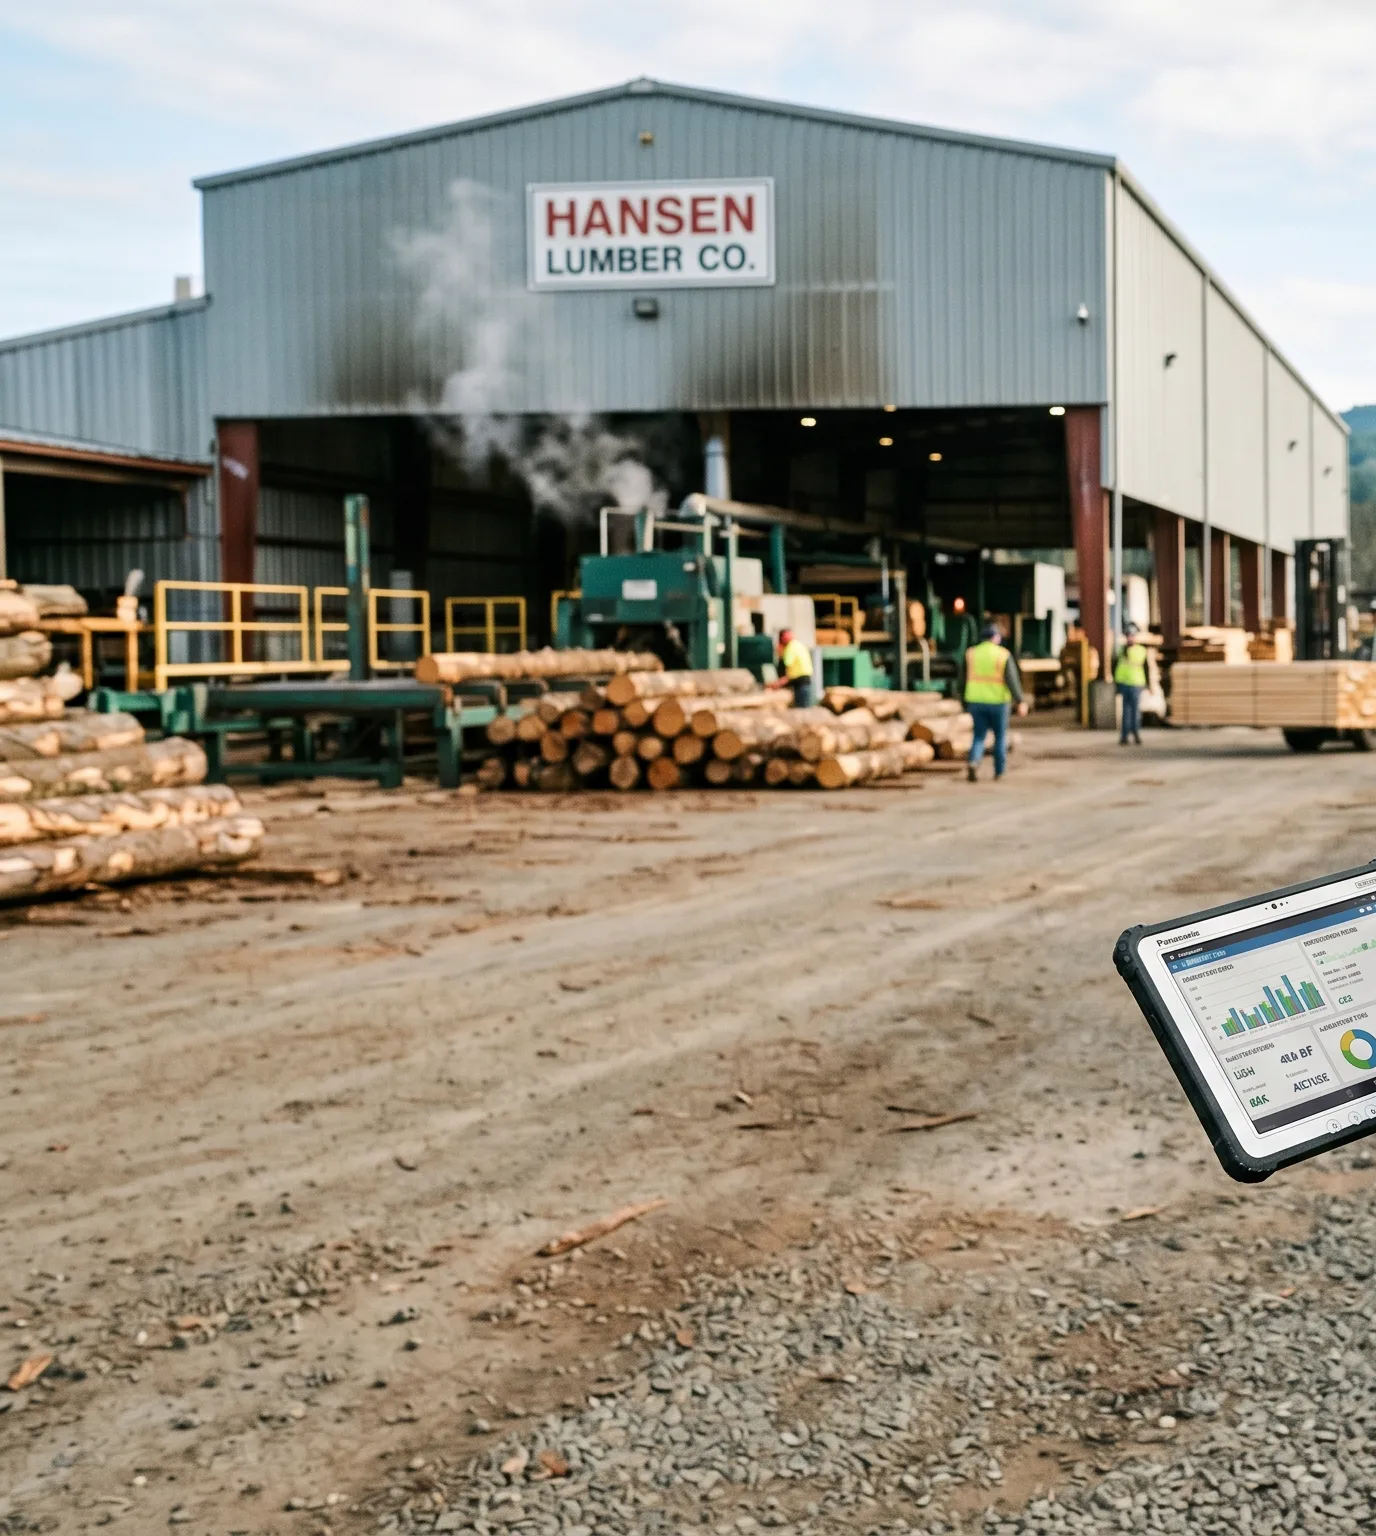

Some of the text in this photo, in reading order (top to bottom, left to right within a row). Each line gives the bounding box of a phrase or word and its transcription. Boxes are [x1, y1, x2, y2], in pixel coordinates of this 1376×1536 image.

[546, 194, 755, 237] HANSEN
[547, 243, 755, 275] LUMBER CO.
